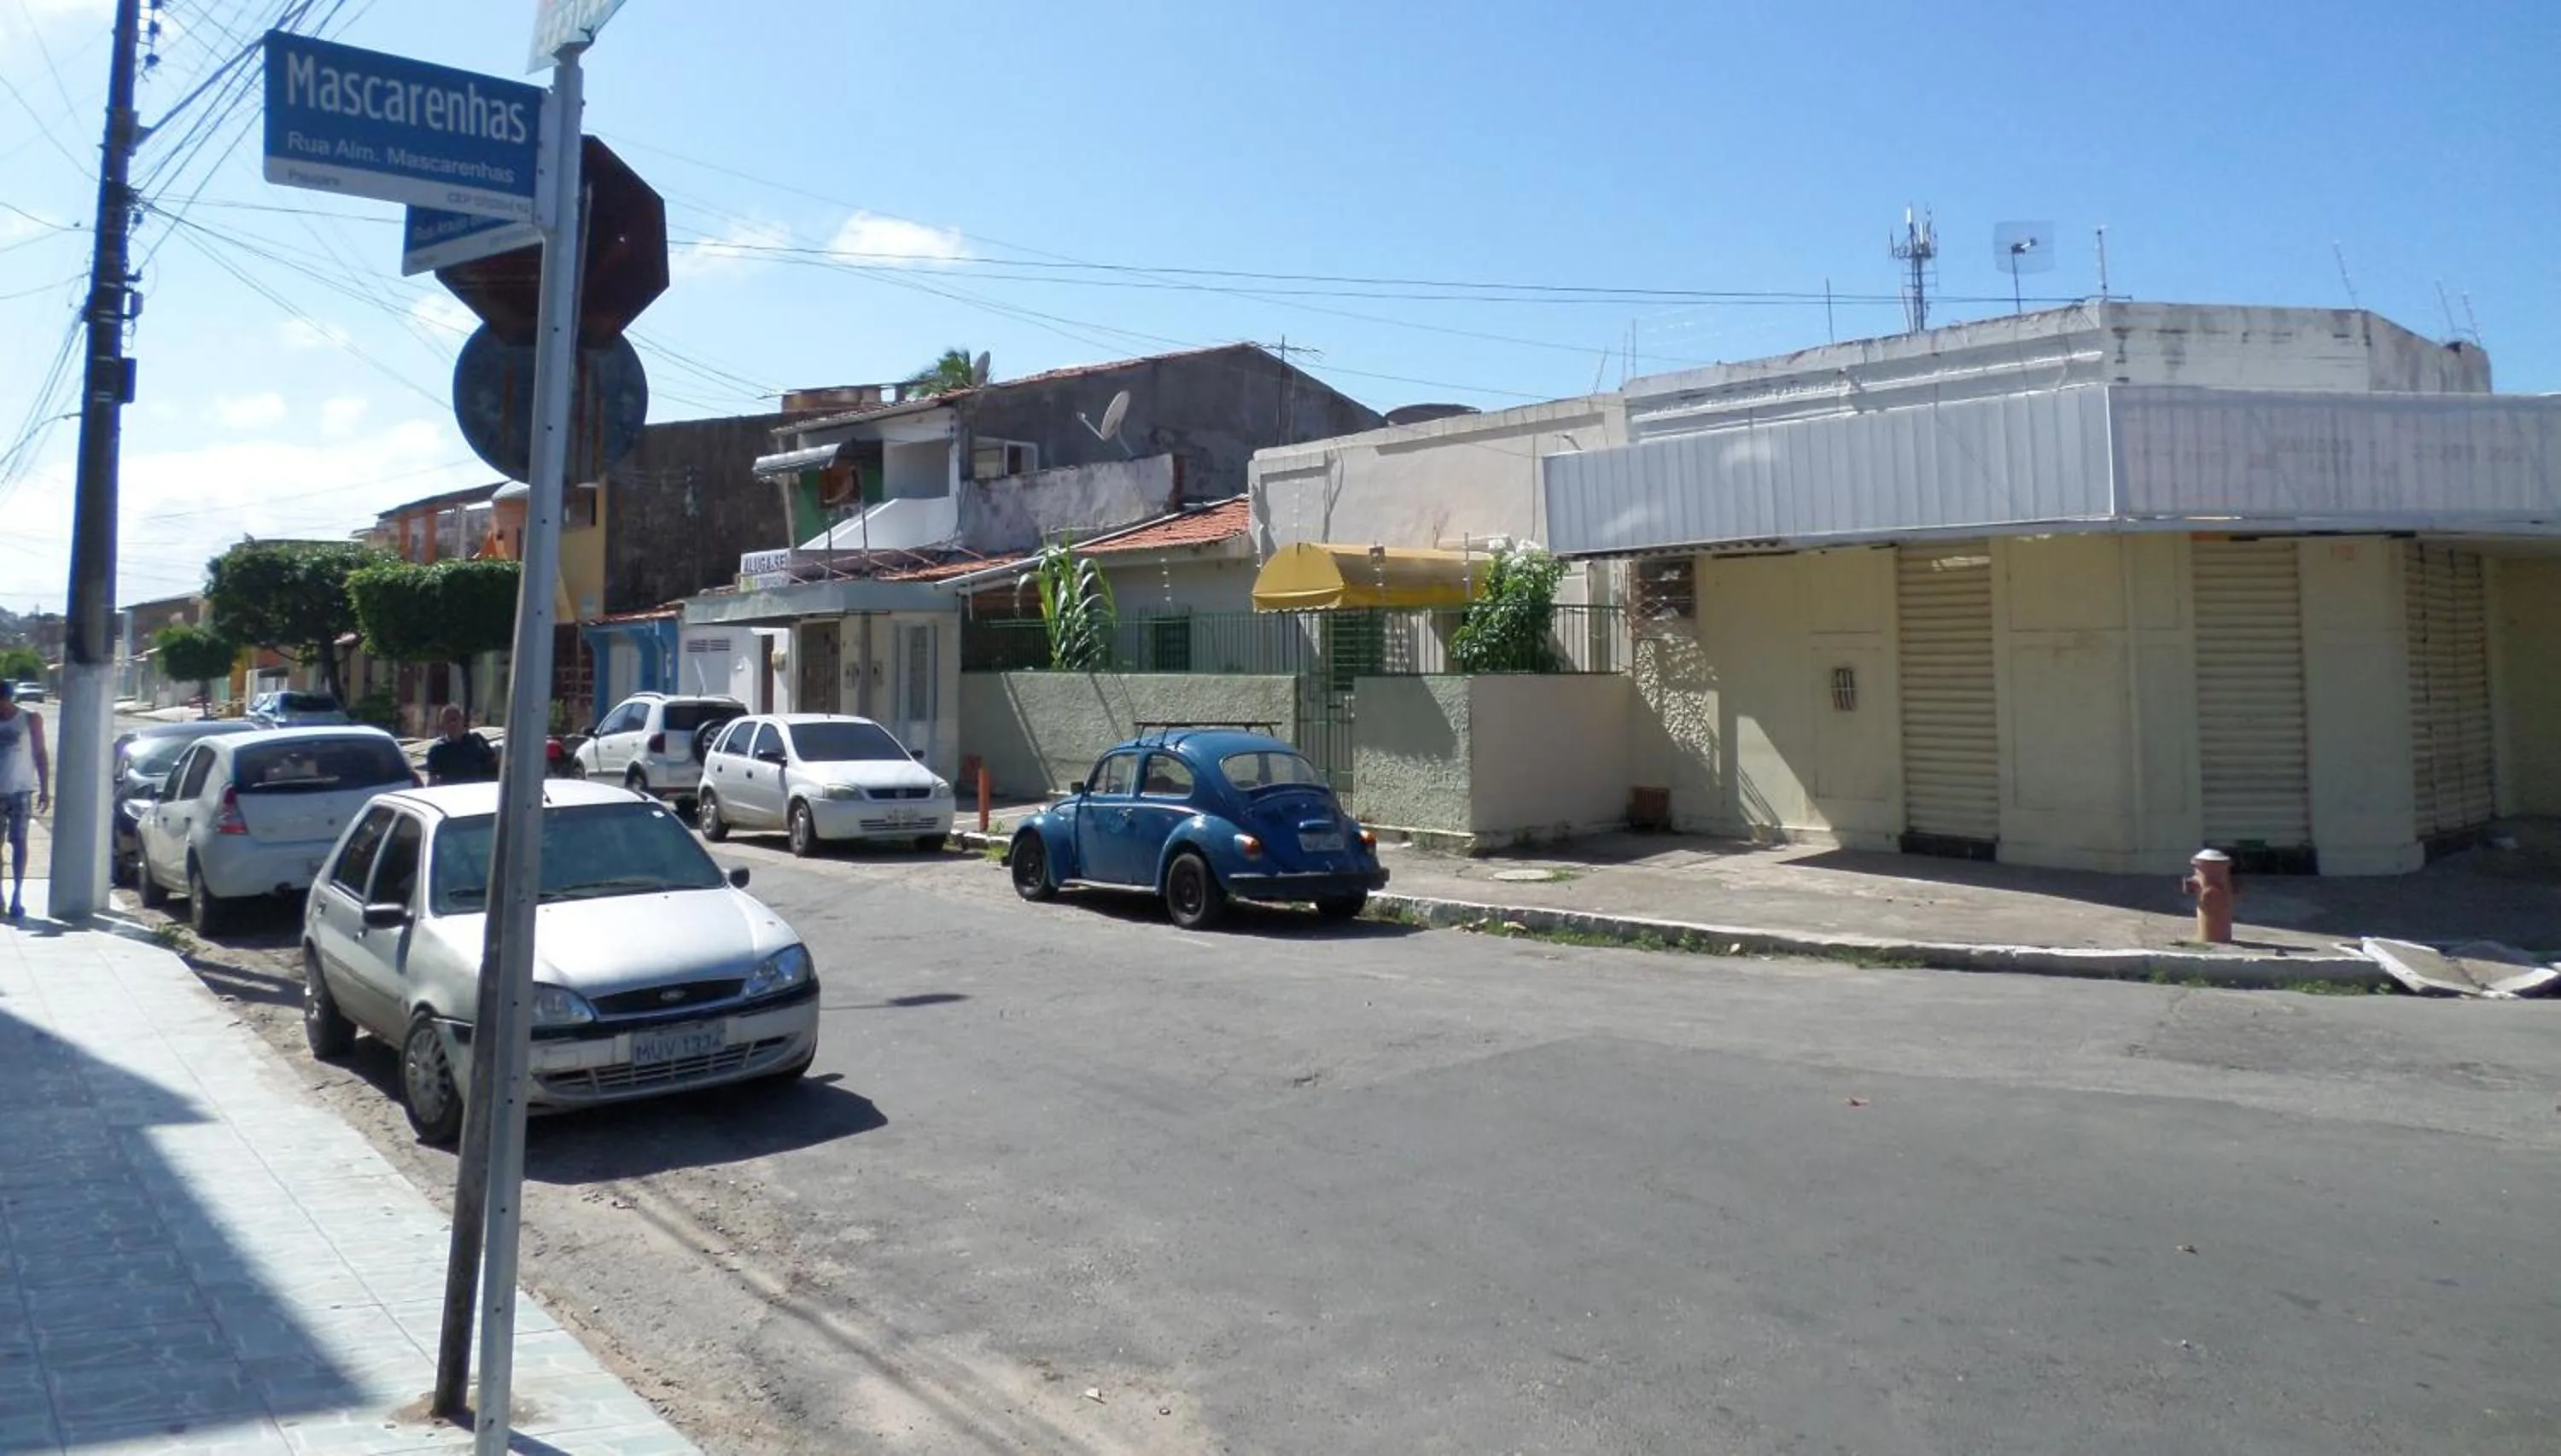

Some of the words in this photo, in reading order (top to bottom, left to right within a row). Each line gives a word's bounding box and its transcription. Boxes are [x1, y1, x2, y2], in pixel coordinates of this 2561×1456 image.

[285, 50, 528, 144] Mascarenhas
[287, 130, 331, 156] Rua
[335, 138, 381, 164] Alm.
[387, 146, 515, 183] Mascarenhas
